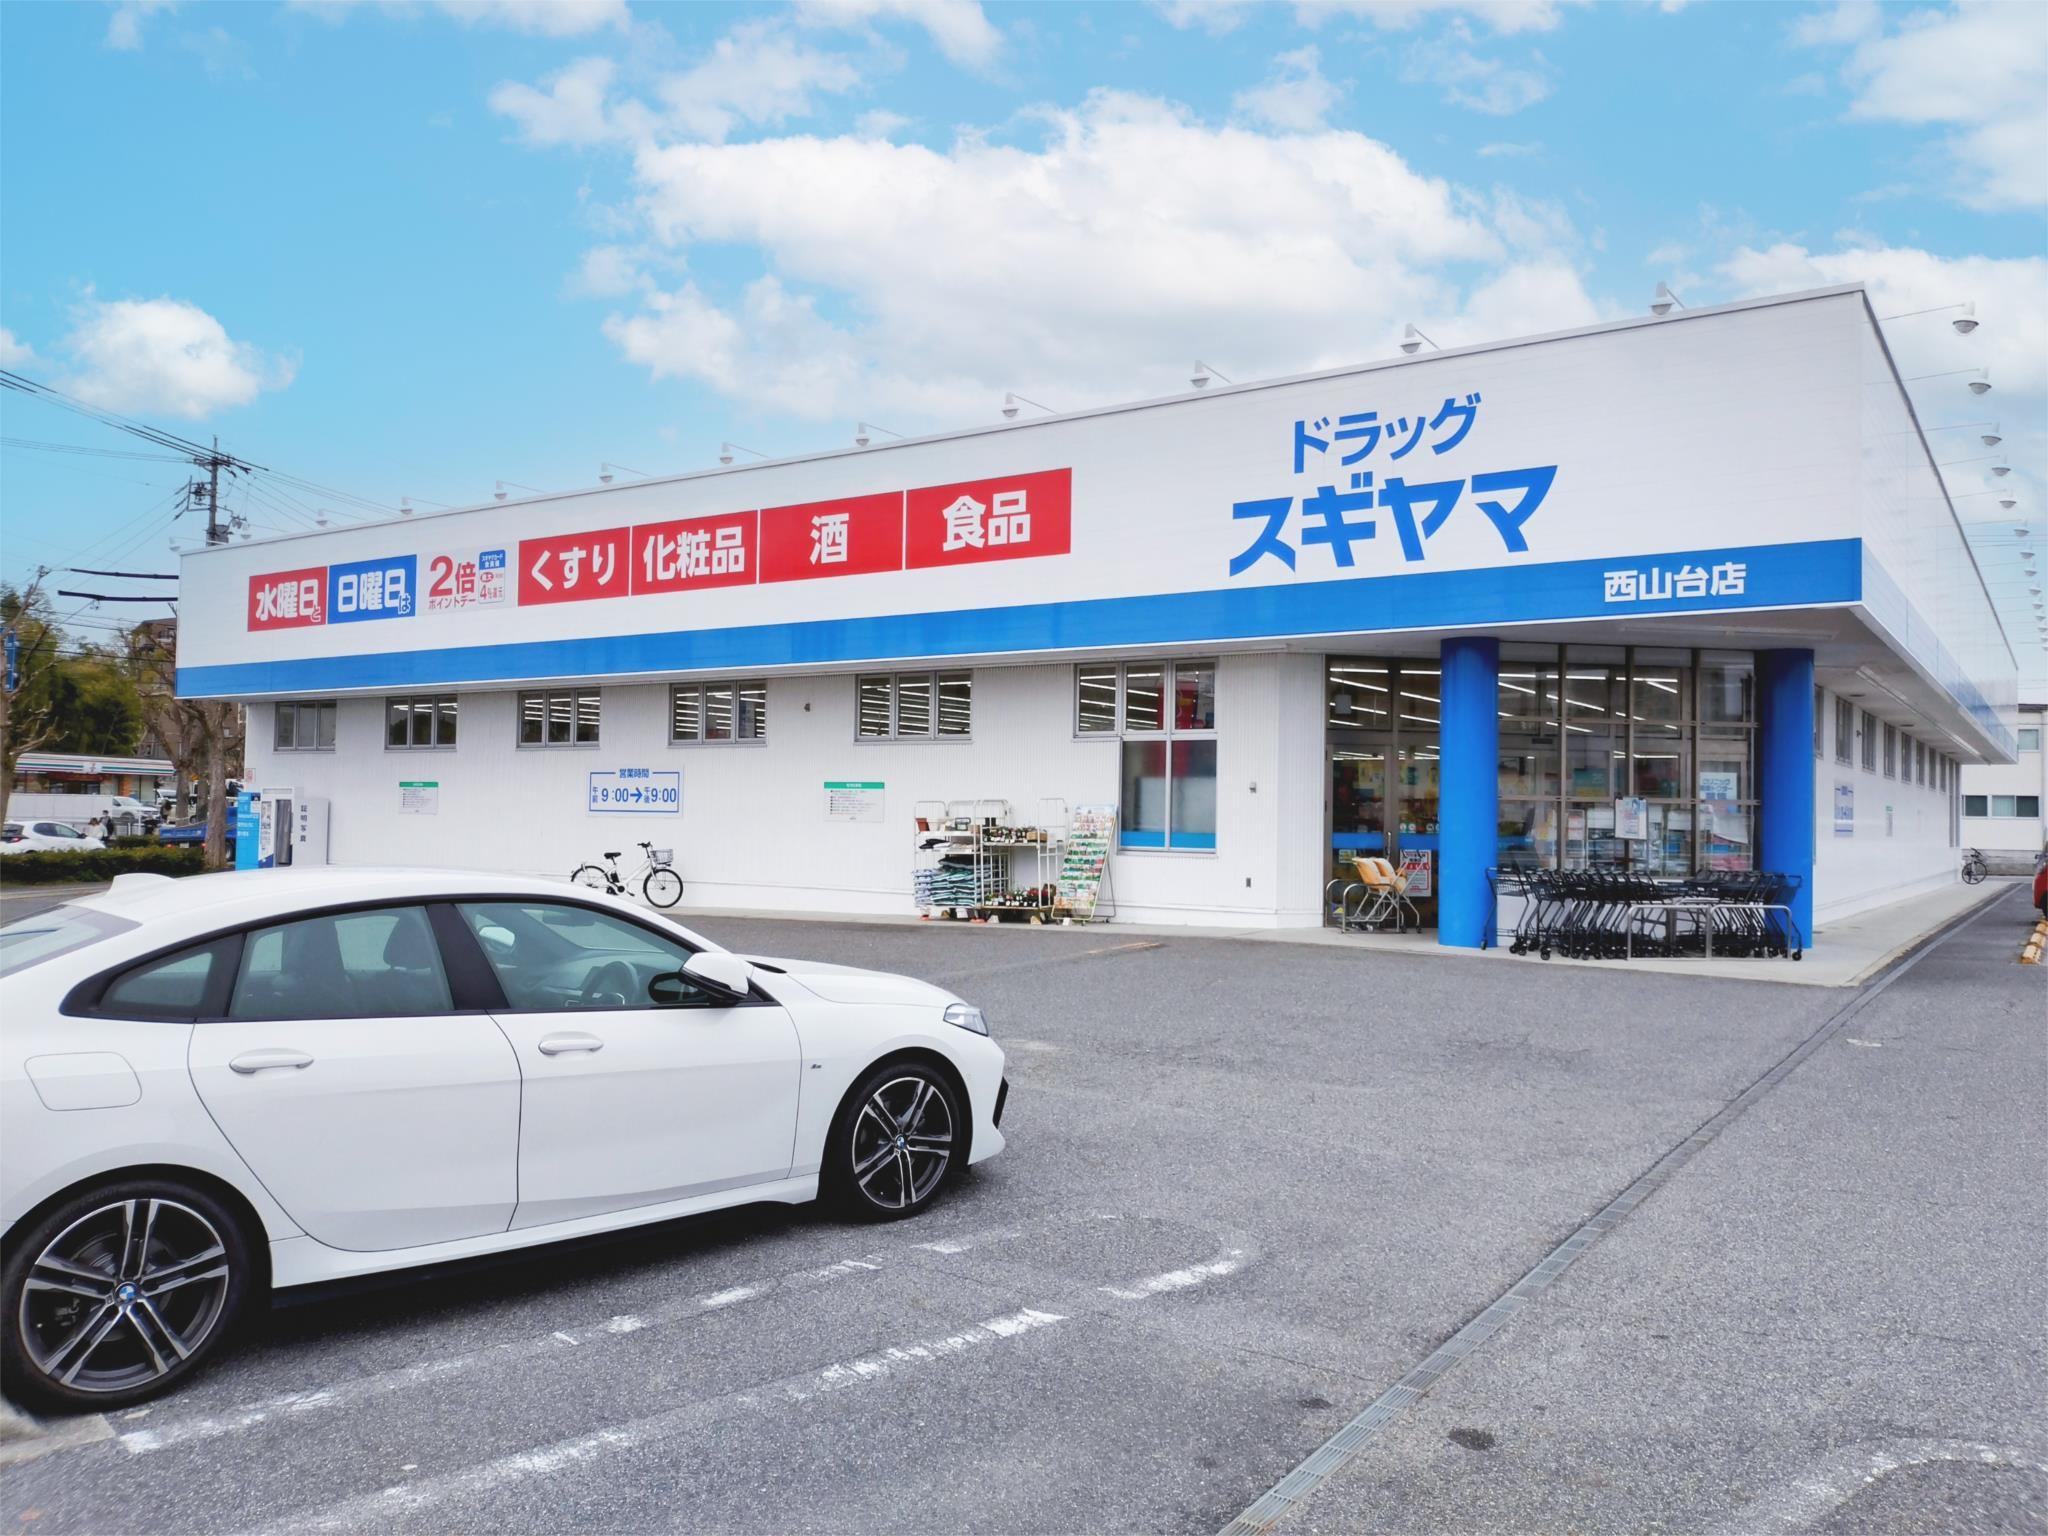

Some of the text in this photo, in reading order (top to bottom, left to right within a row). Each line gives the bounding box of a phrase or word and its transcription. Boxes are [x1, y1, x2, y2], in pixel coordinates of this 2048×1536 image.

[1293, 391, 1482, 475] ドラッグ
[809, 512, 850, 566] 酒
[942, 489, 1031, 552] 食品
[1229, 465, 1558, 577] スギヤマ
[429, 555, 476, 598] 2倍
[531, 542, 616, 592] くすり
[643, 526, 745, 583] 化粧品
[255, 578, 321, 622] 水曜日と
[337, 568, 411, 614] 日曜日は
[428, 595, 476, 610] ポイントデー
[1603, 561, 1747, 604] 西山台店
[619, 767, 650, 779] 営業時間
[651, 788, 677, 803] 9:00
